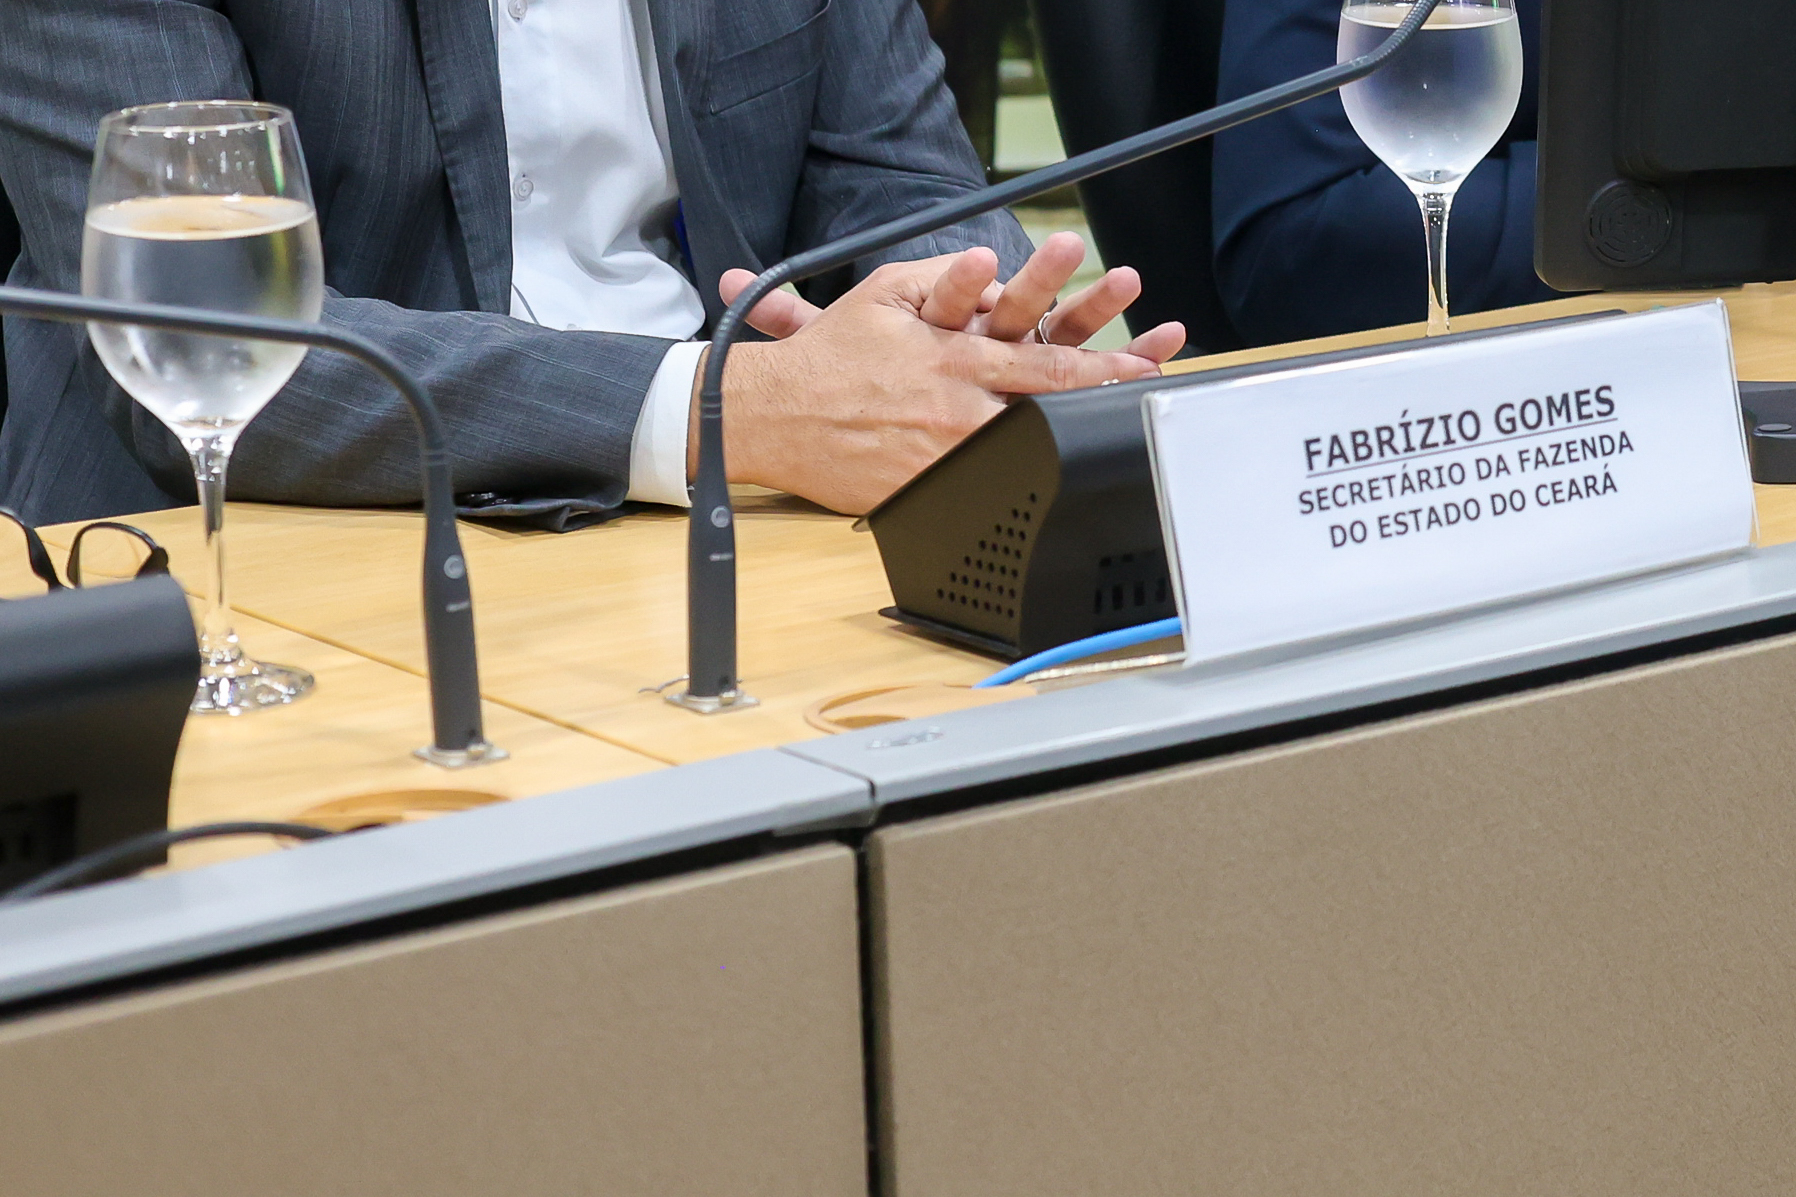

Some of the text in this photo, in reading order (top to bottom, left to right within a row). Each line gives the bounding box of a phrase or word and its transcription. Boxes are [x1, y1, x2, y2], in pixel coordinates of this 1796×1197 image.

[1304, 385, 1615, 471] FABRÍZIO GOMES
[1298, 430, 1634, 515] SECRETÁRIO DA FAZENDA
[1329, 463, 1618, 548] DO ESTADO DO CEARÁ
